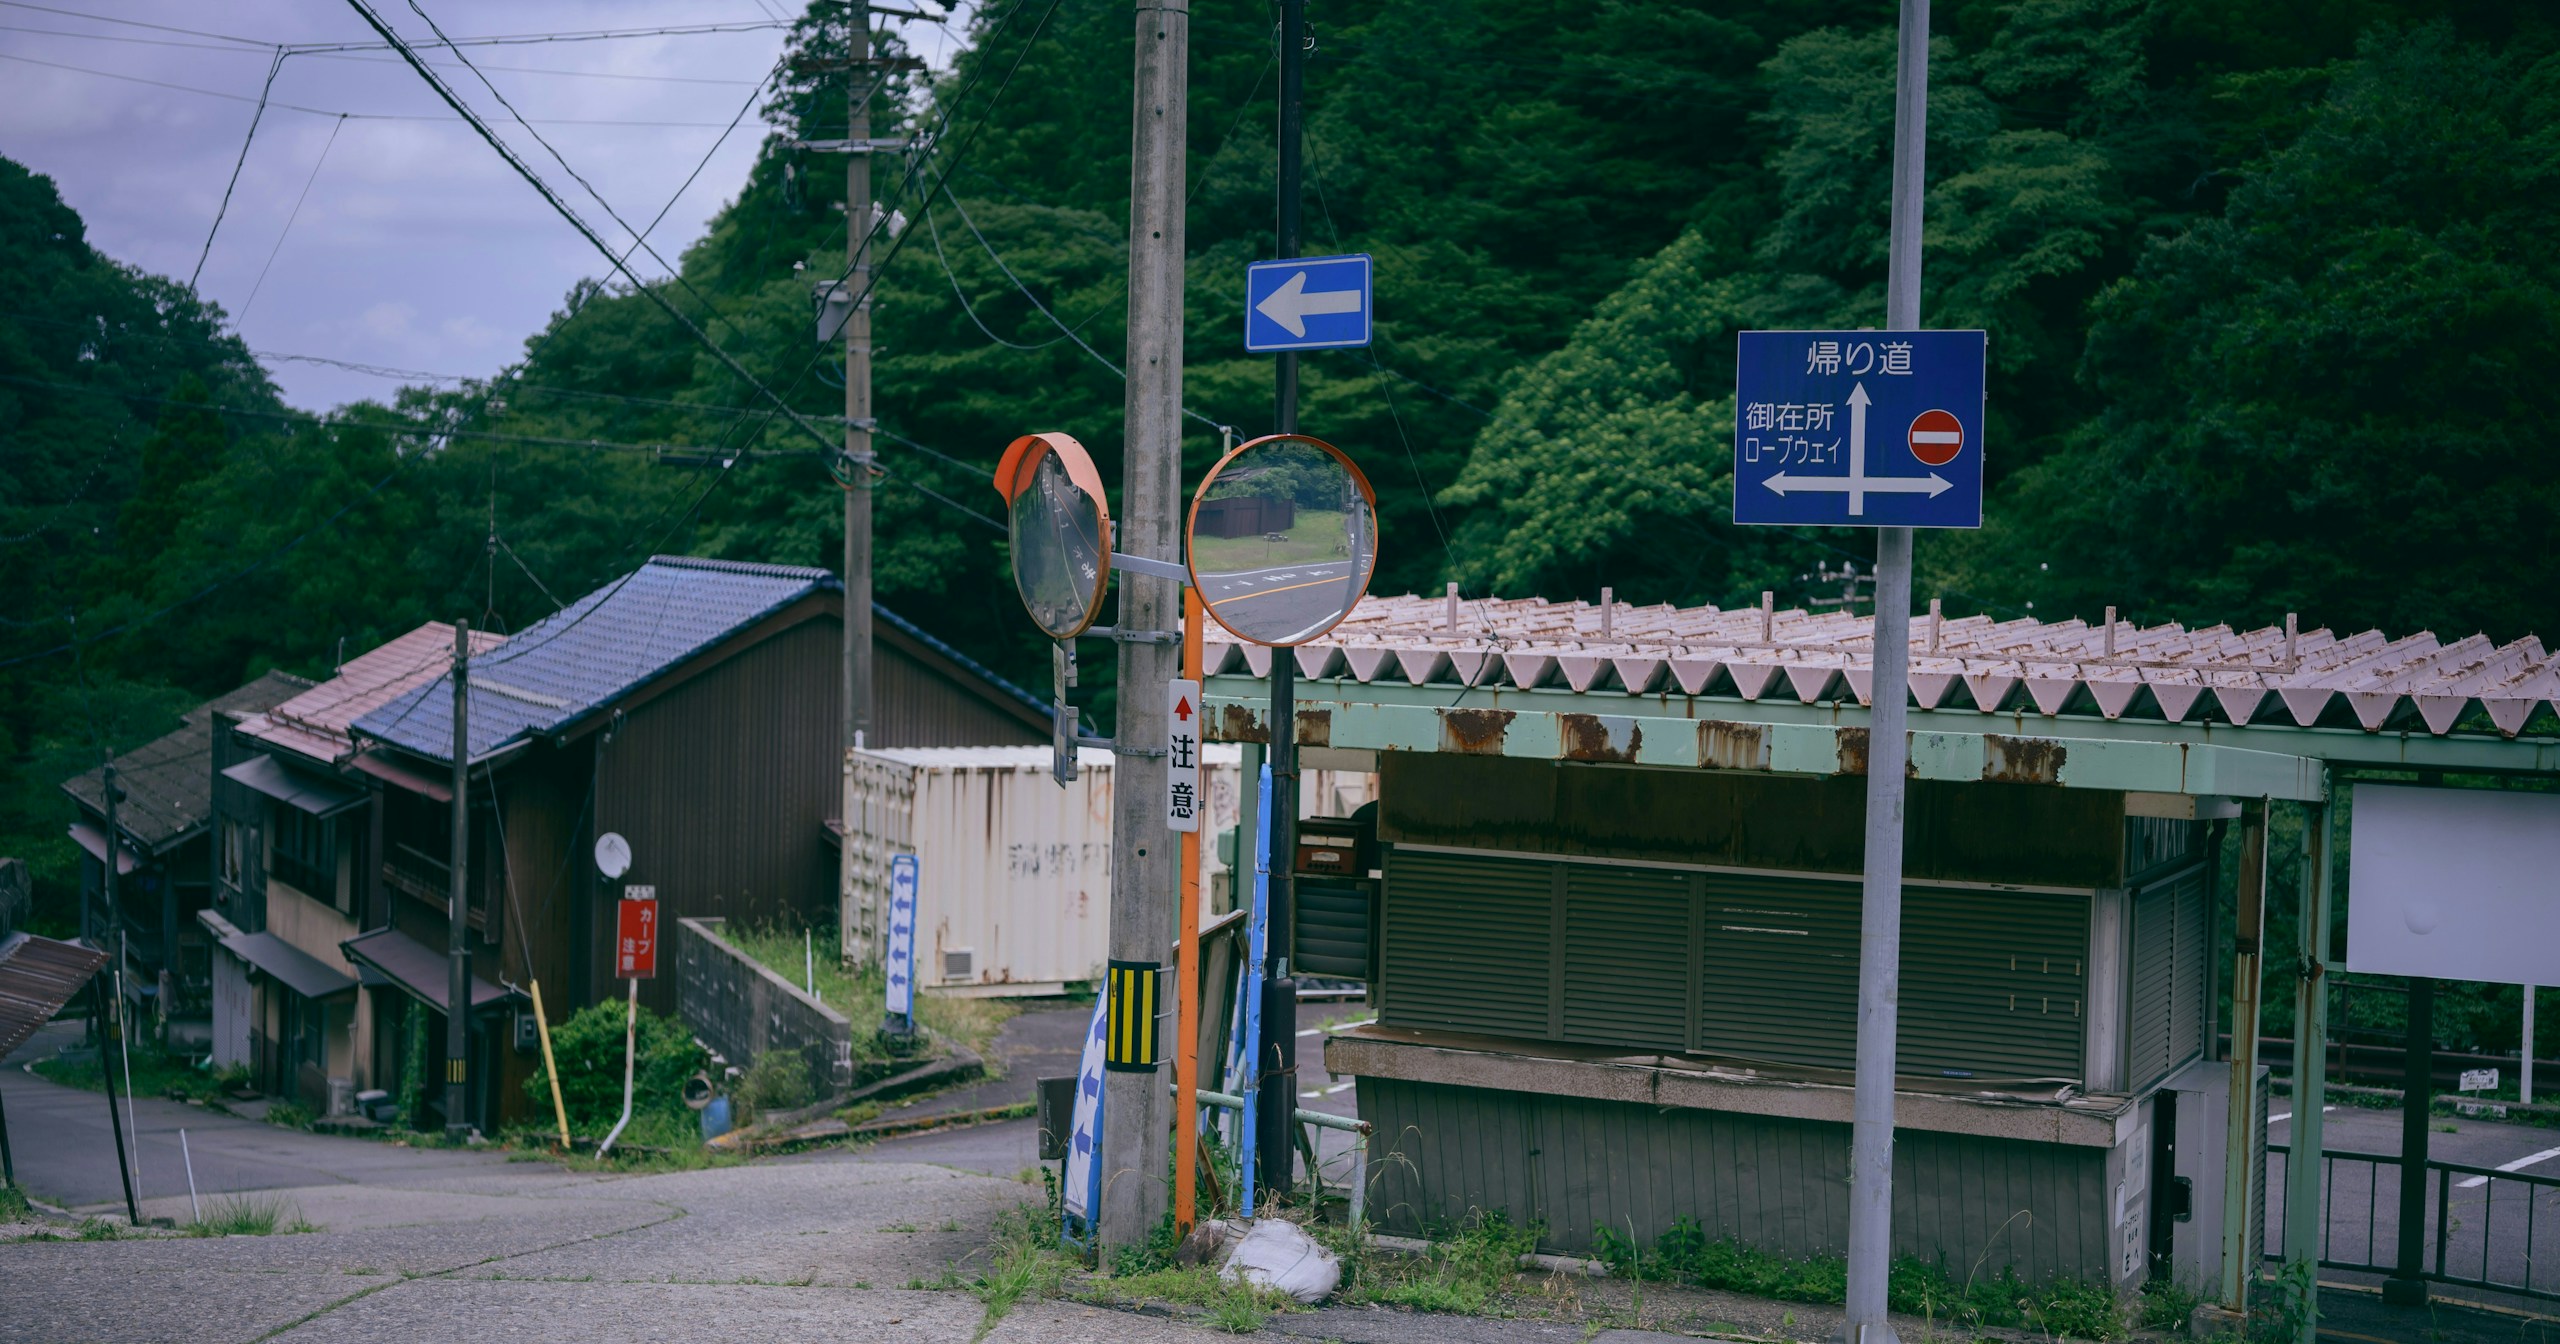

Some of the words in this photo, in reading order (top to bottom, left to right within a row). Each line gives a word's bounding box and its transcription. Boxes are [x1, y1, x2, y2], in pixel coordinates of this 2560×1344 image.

[1806, 340, 1913, 376] 帰り道
[1746, 402, 1834, 431] 御在所
[1745, 435, 1841, 464] ロープウェイ
[1171, 734, 1195, 819] 注意
[638, 907, 652, 955] カーブ
